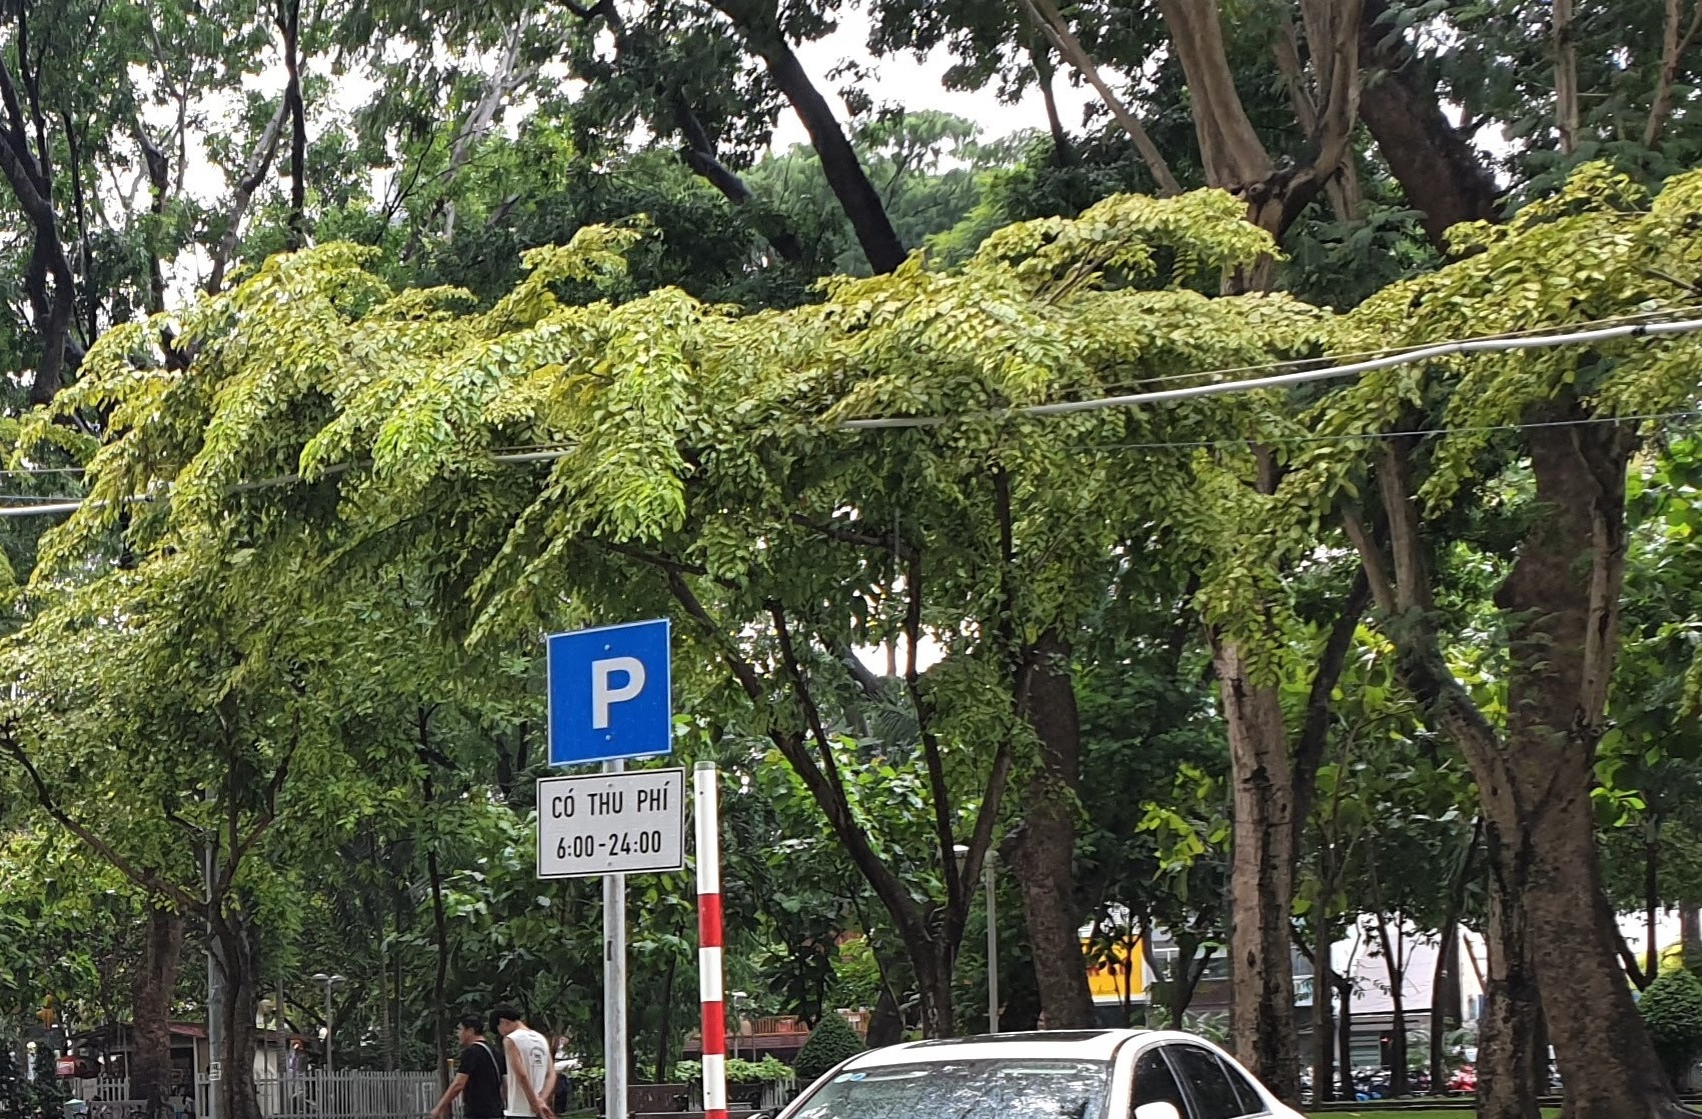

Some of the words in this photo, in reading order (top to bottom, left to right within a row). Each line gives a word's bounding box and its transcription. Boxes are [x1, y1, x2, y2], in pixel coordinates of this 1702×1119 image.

[591, 656, 646, 730] P
[552, 787, 575, 819] CÓ
[587, 791, 623, 816] THU
[637, 780, 670, 813] PHÍ
[556, 830, 662, 860] 6:00-24:00
